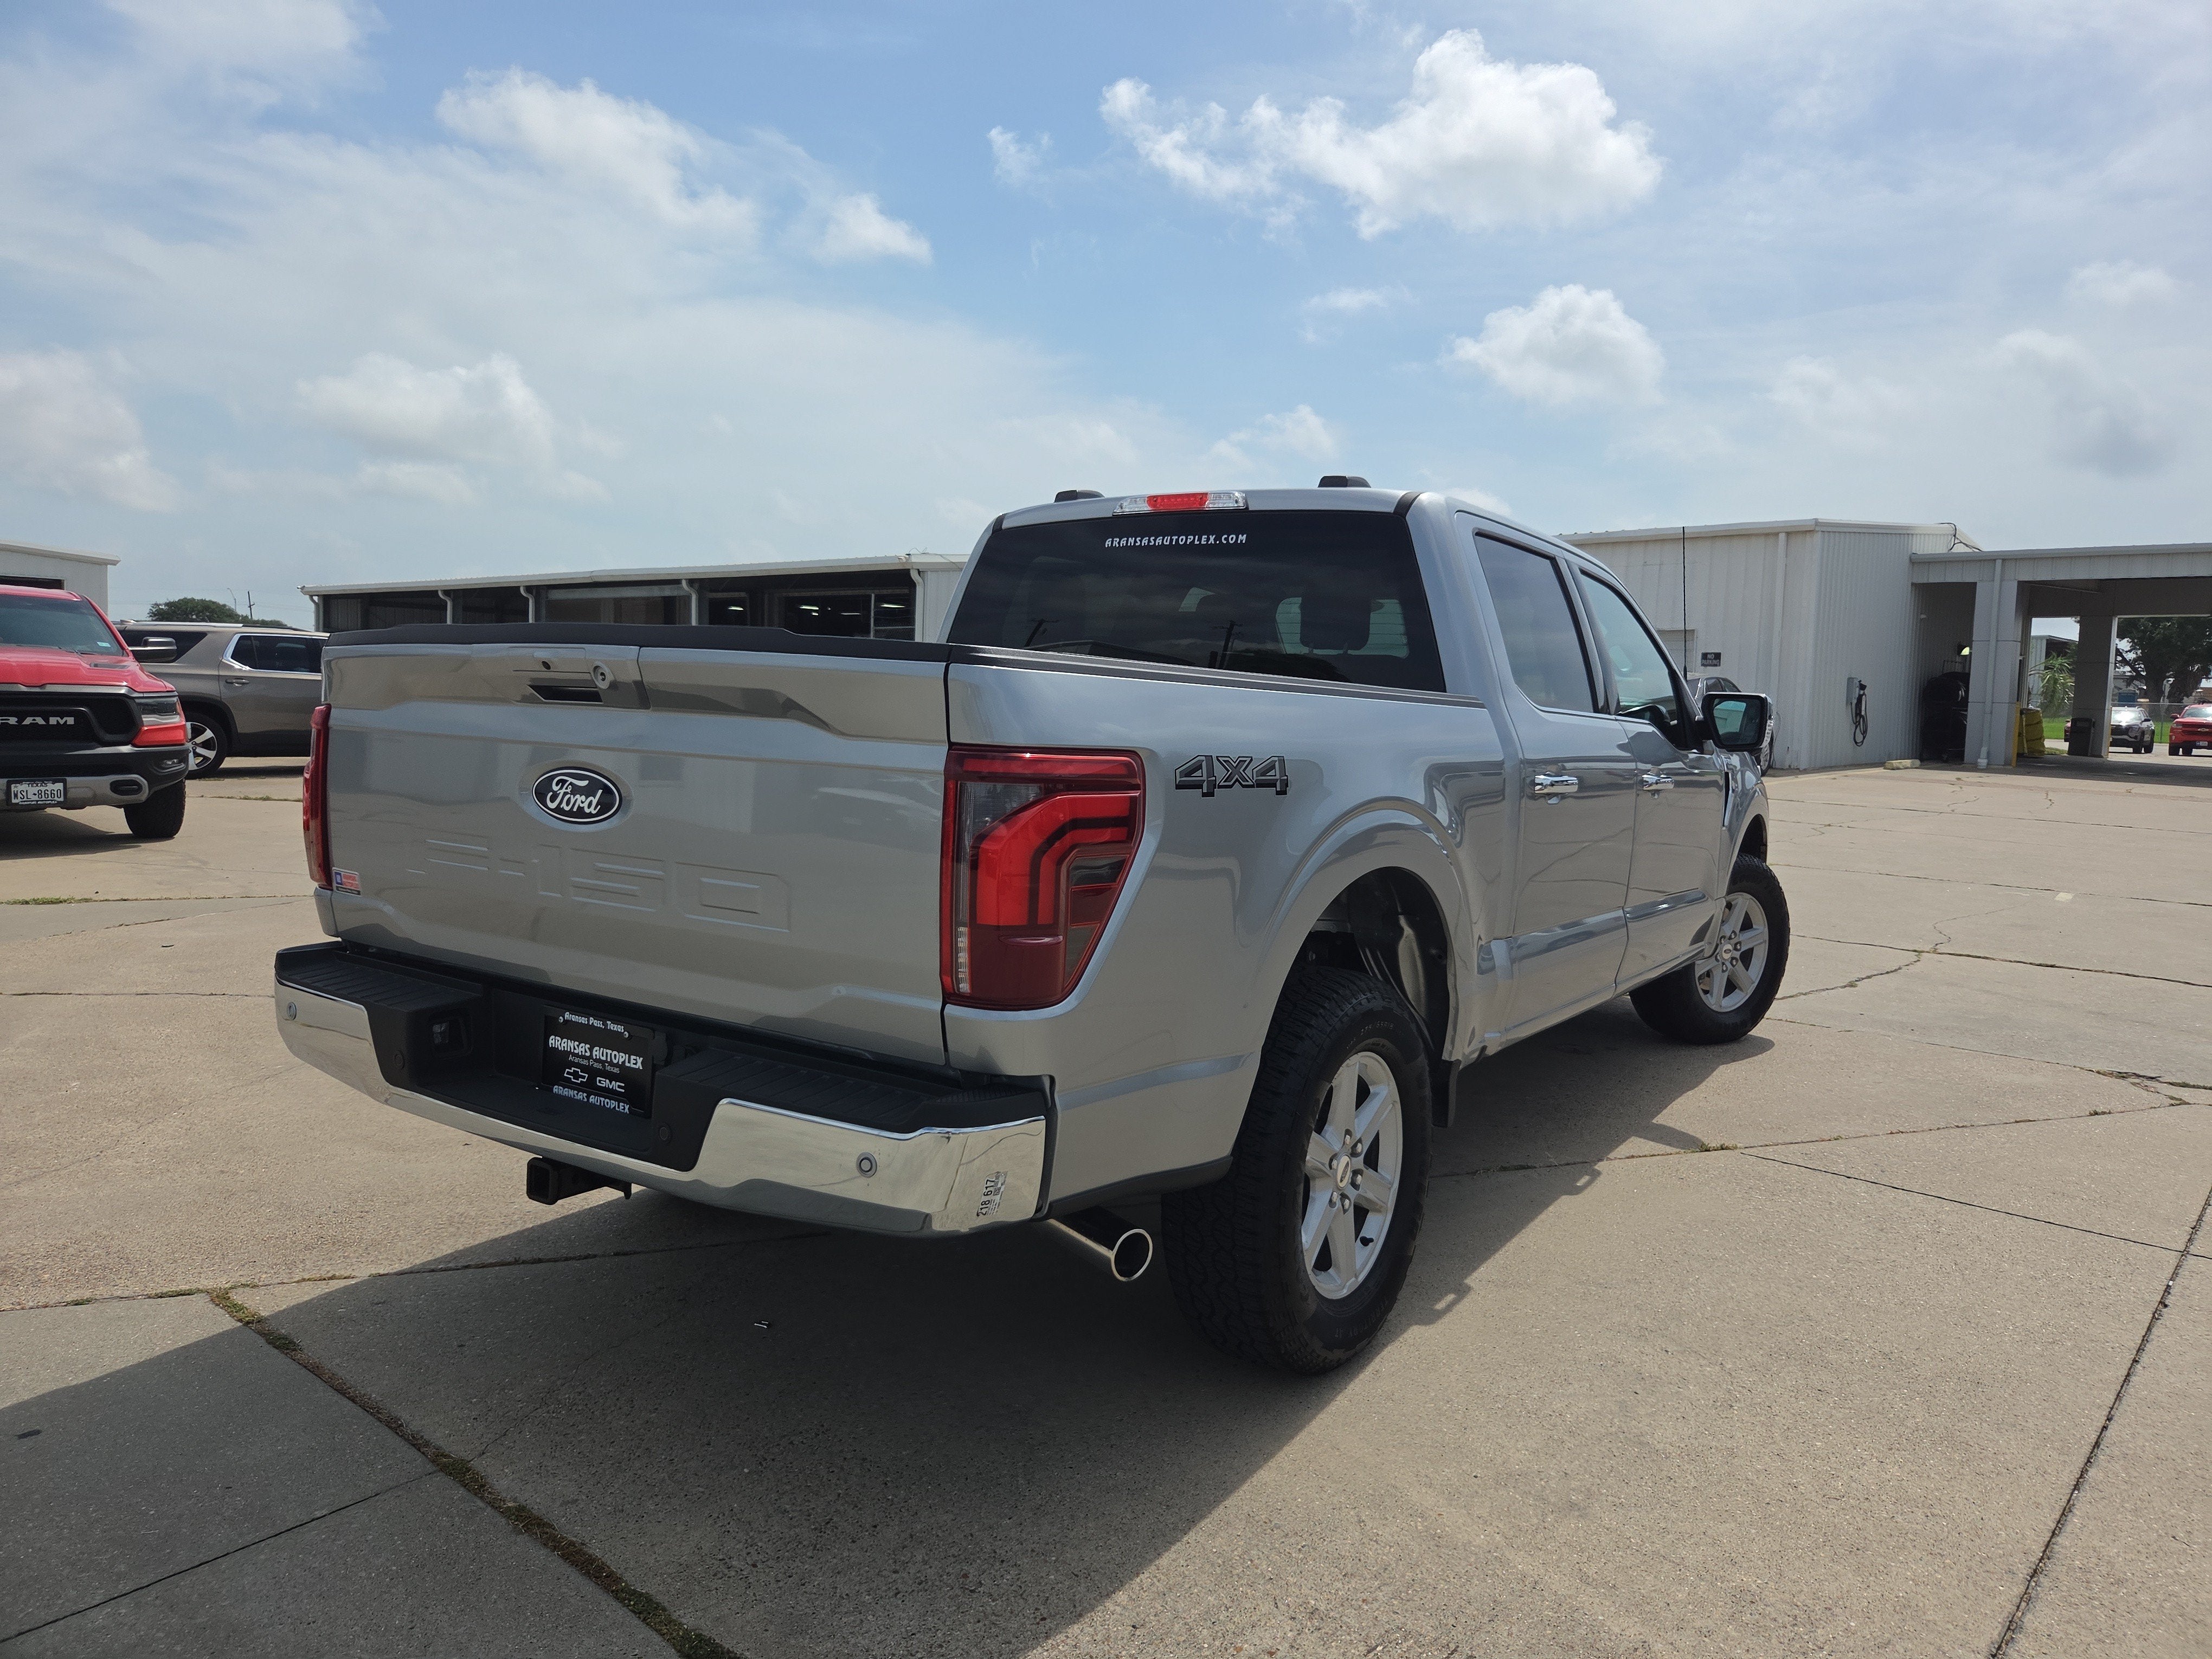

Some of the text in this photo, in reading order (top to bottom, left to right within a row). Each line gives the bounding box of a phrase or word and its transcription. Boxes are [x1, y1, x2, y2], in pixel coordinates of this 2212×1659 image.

[1105, 534, 1246, 548] ARANSASAUTOPLEX.COM
[0, 717, 74, 725] RAM
[546, 776, 603, 814] Ford
[564, 1012, 624, 1032] Aransas Pass, Texas
[549, 1035, 644, 1070] ARANSAS AUTOPLEX
[569, 1054, 620, 1073] Aransas Pass, Texas
[596, 1077, 625, 1092] GMC
[553, 1085, 629, 1114] ARANSAS AUTOPLEX
[983, 1179, 995, 1196] 617
